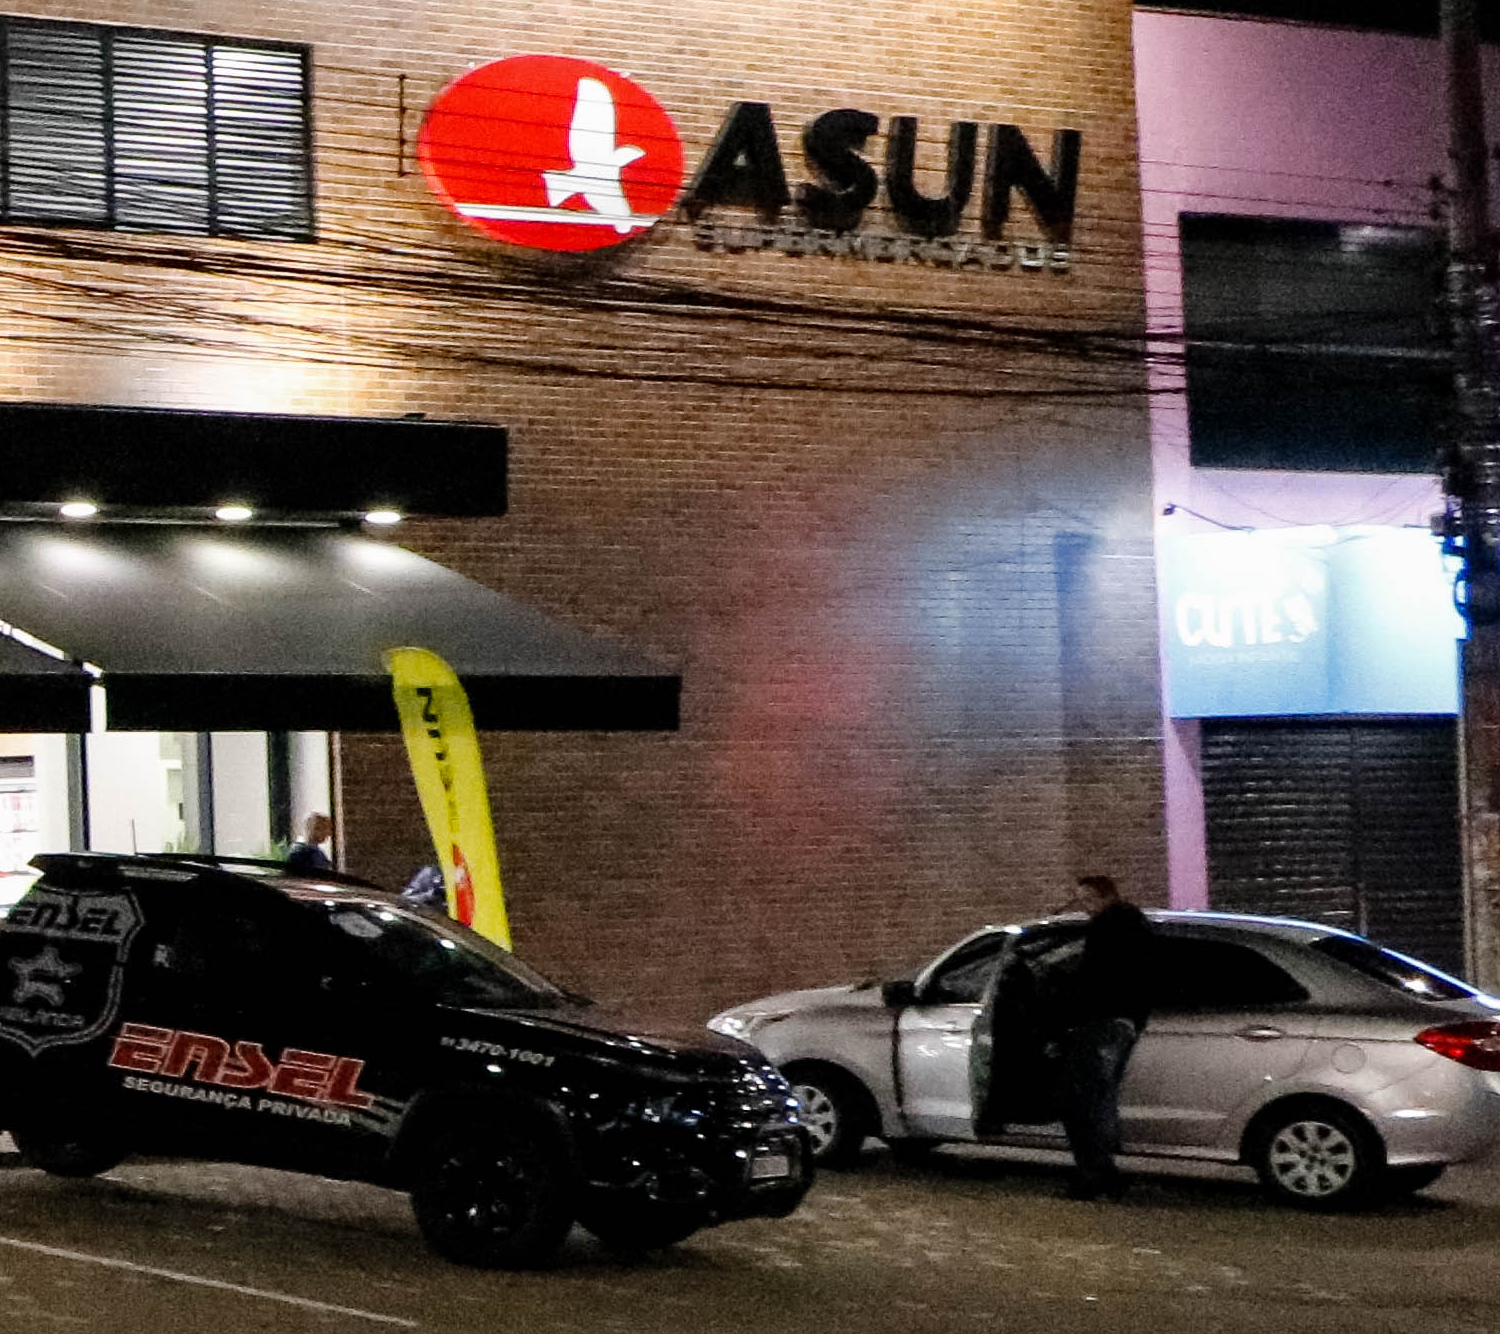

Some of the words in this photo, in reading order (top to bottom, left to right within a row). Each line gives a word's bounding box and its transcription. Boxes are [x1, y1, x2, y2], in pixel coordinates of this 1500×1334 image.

[682, 102, 1080, 245] ASUN
[122, 1075, 251, 1110] SEGURANÇA
[257, 1099, 351, 1126] PRIVADA
